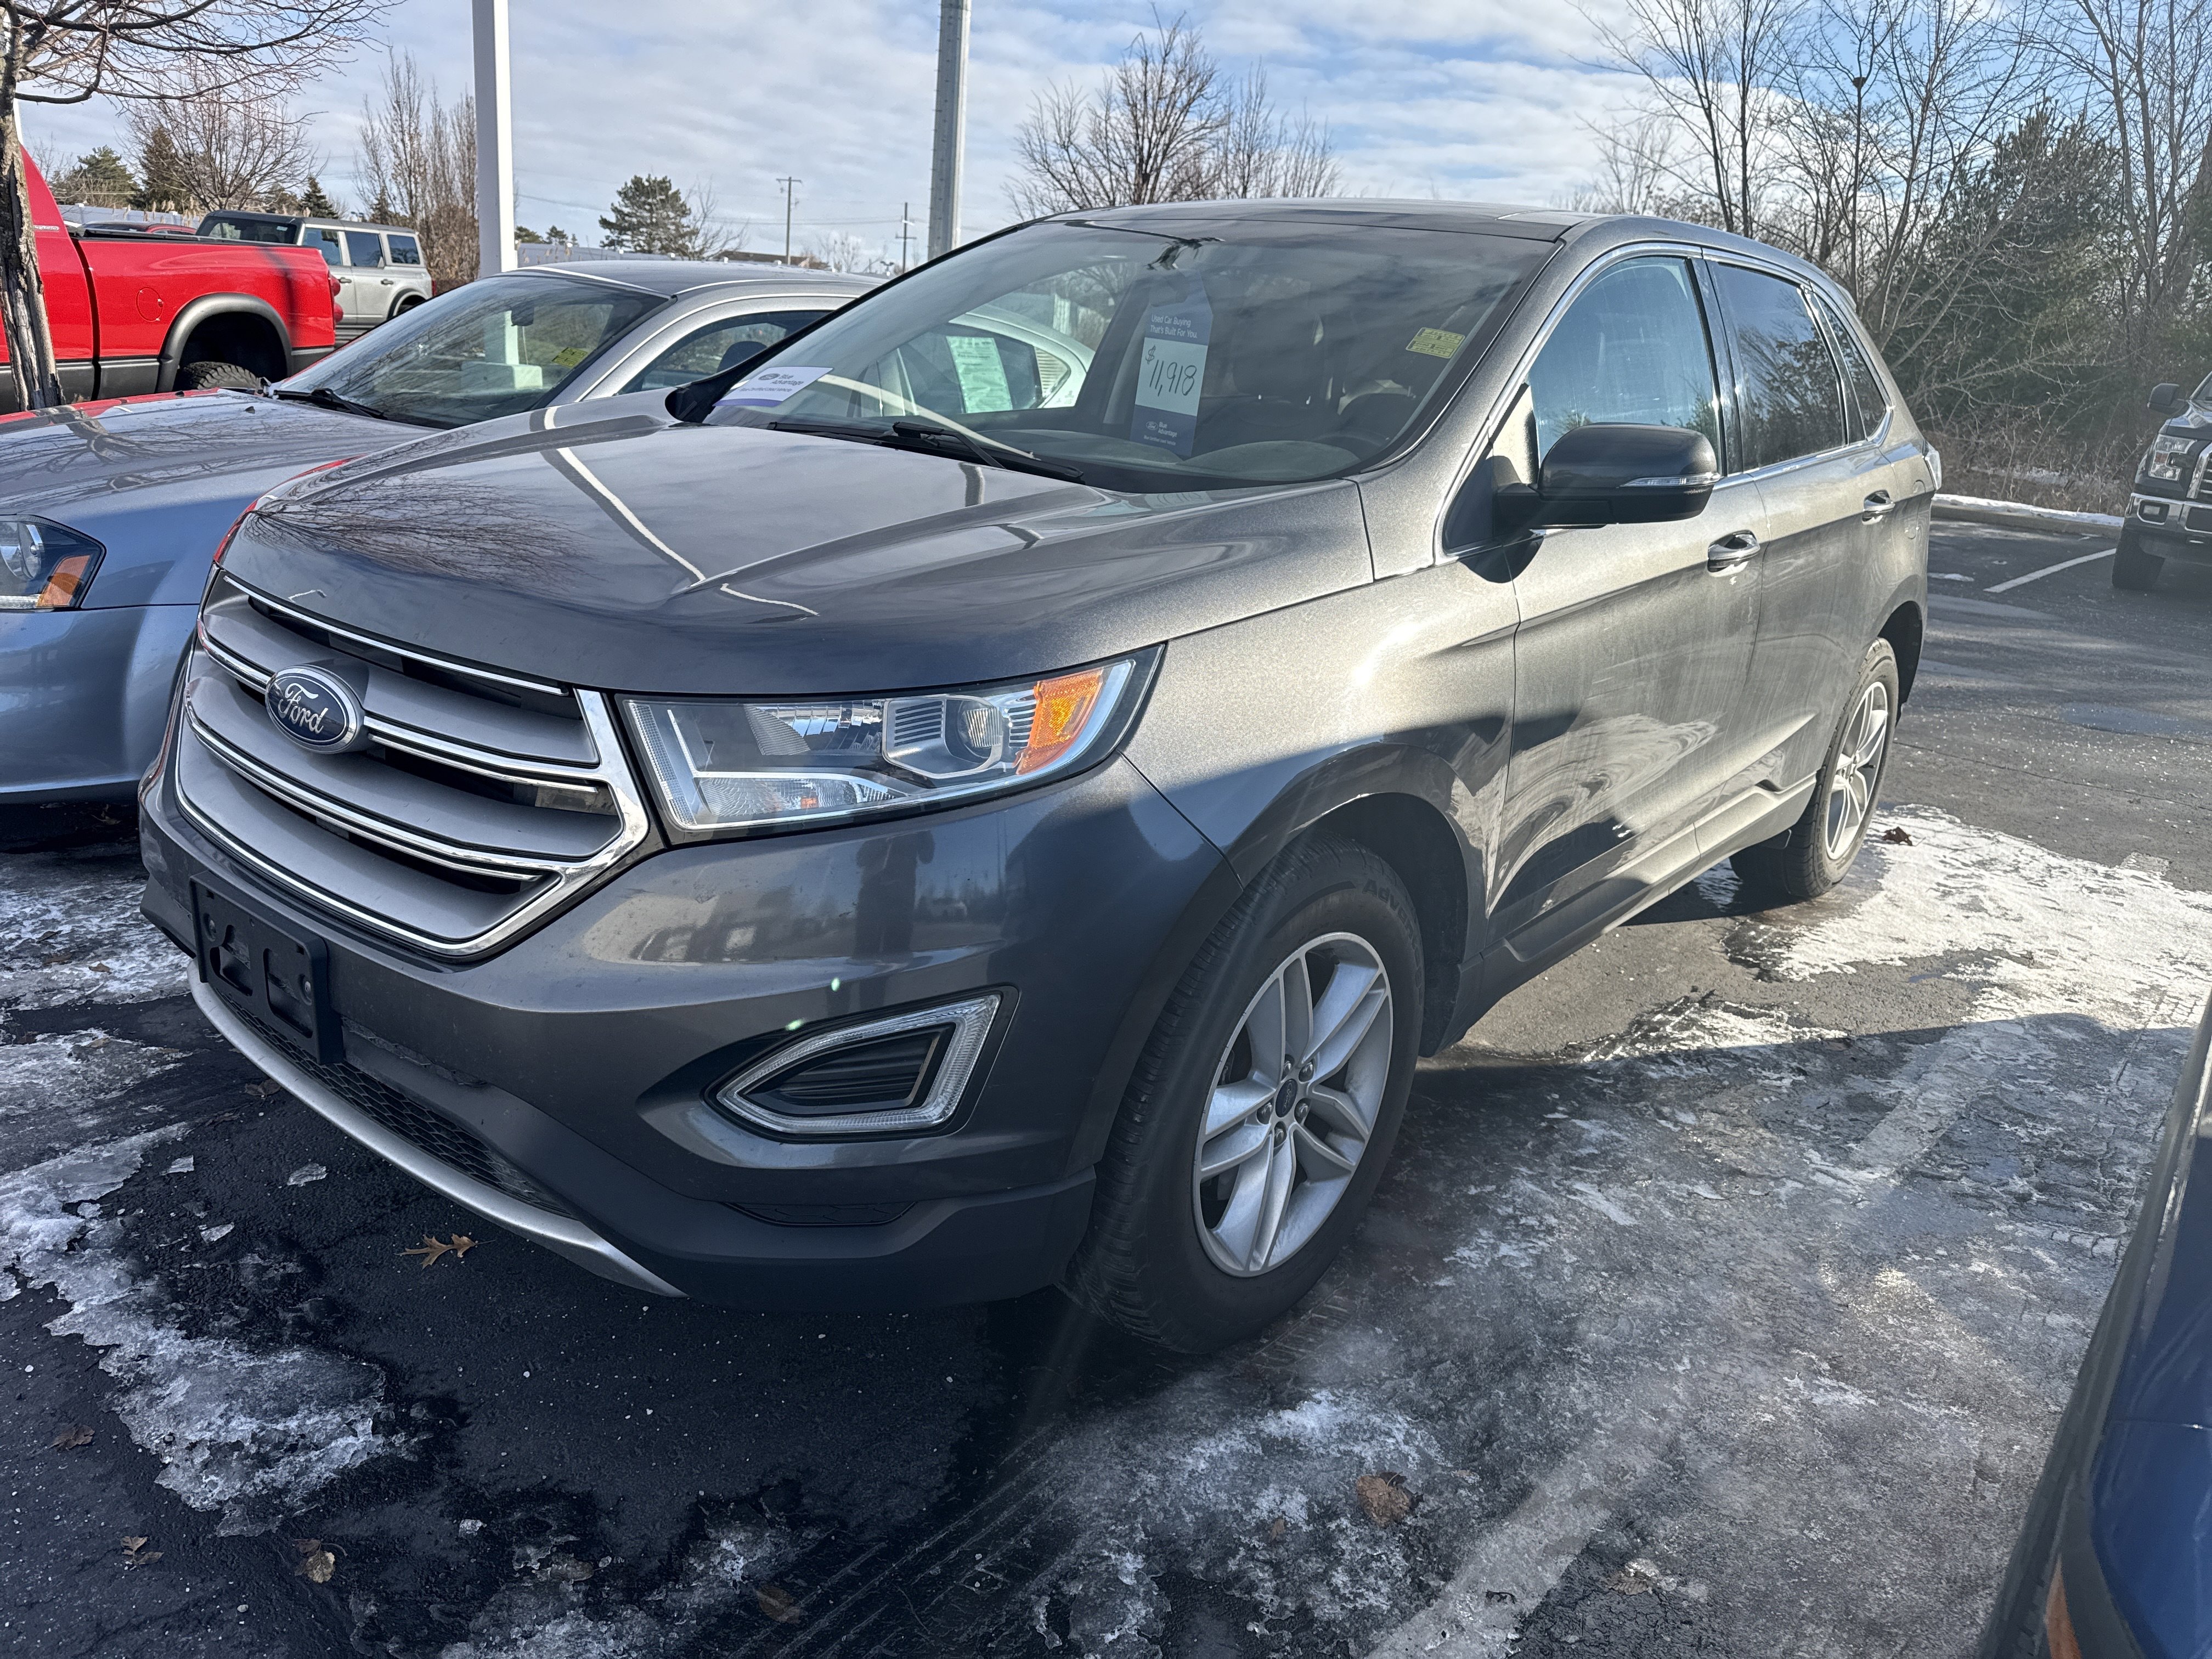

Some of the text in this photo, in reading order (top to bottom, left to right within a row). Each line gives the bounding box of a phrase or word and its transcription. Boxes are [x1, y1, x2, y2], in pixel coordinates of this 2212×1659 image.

[1151, 314, 1192, 328] Used Car Buying
[1150, 325, 1164, 334] That's
[1165, 326, 1176, 336] Built
[1177, 328, 1186, 337] For
[1158, 428, 1177, 438] Advantage
[277, 682, 329, 734] Ford
